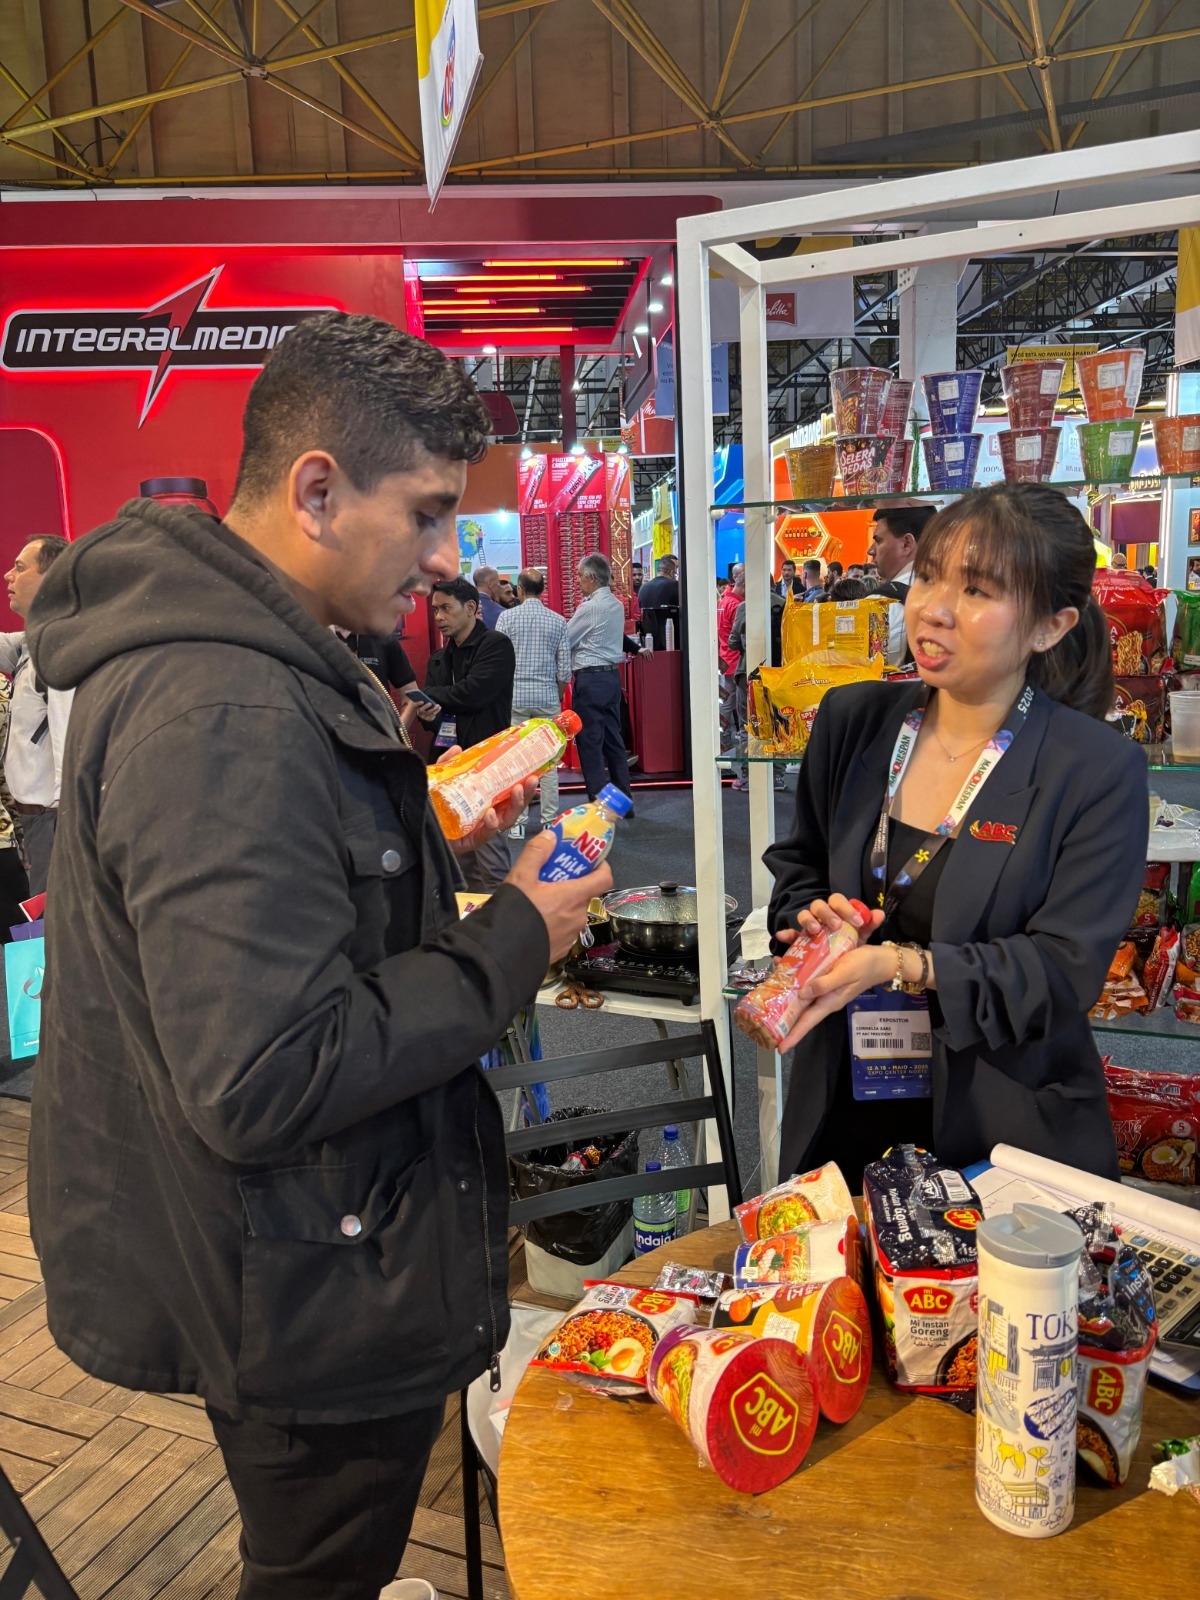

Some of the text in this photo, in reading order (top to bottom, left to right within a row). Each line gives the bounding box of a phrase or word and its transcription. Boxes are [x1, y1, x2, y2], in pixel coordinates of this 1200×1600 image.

[766, 300, 788, 316] elitta
[16, 325, 297, 353] INTEGRALMEDIC
[841, 446, 875, 466] SELERA
[841, 457, 873, 475] PEDAS
[1017, 685, 1034, 714] 2025
[801, 711, 814, 720] SPI
[979, 821, 1018, 839] ABC
[1177, 1122, 1185, 1131] 5
[1125, 1270, 1149, 1295] Insta
[910, 1293, 948, 1309] ABC
[910, 1319, 949, 1328] Mi Instan
[910, 1326, 949, 1337] Goreng
[832, 1323, 860, 1365] ABC
[1094, 1368, 1117, 1410] ABC
[745, 1386, 792, 1436] ABC
[749, 1423, 762, 1437] mi
